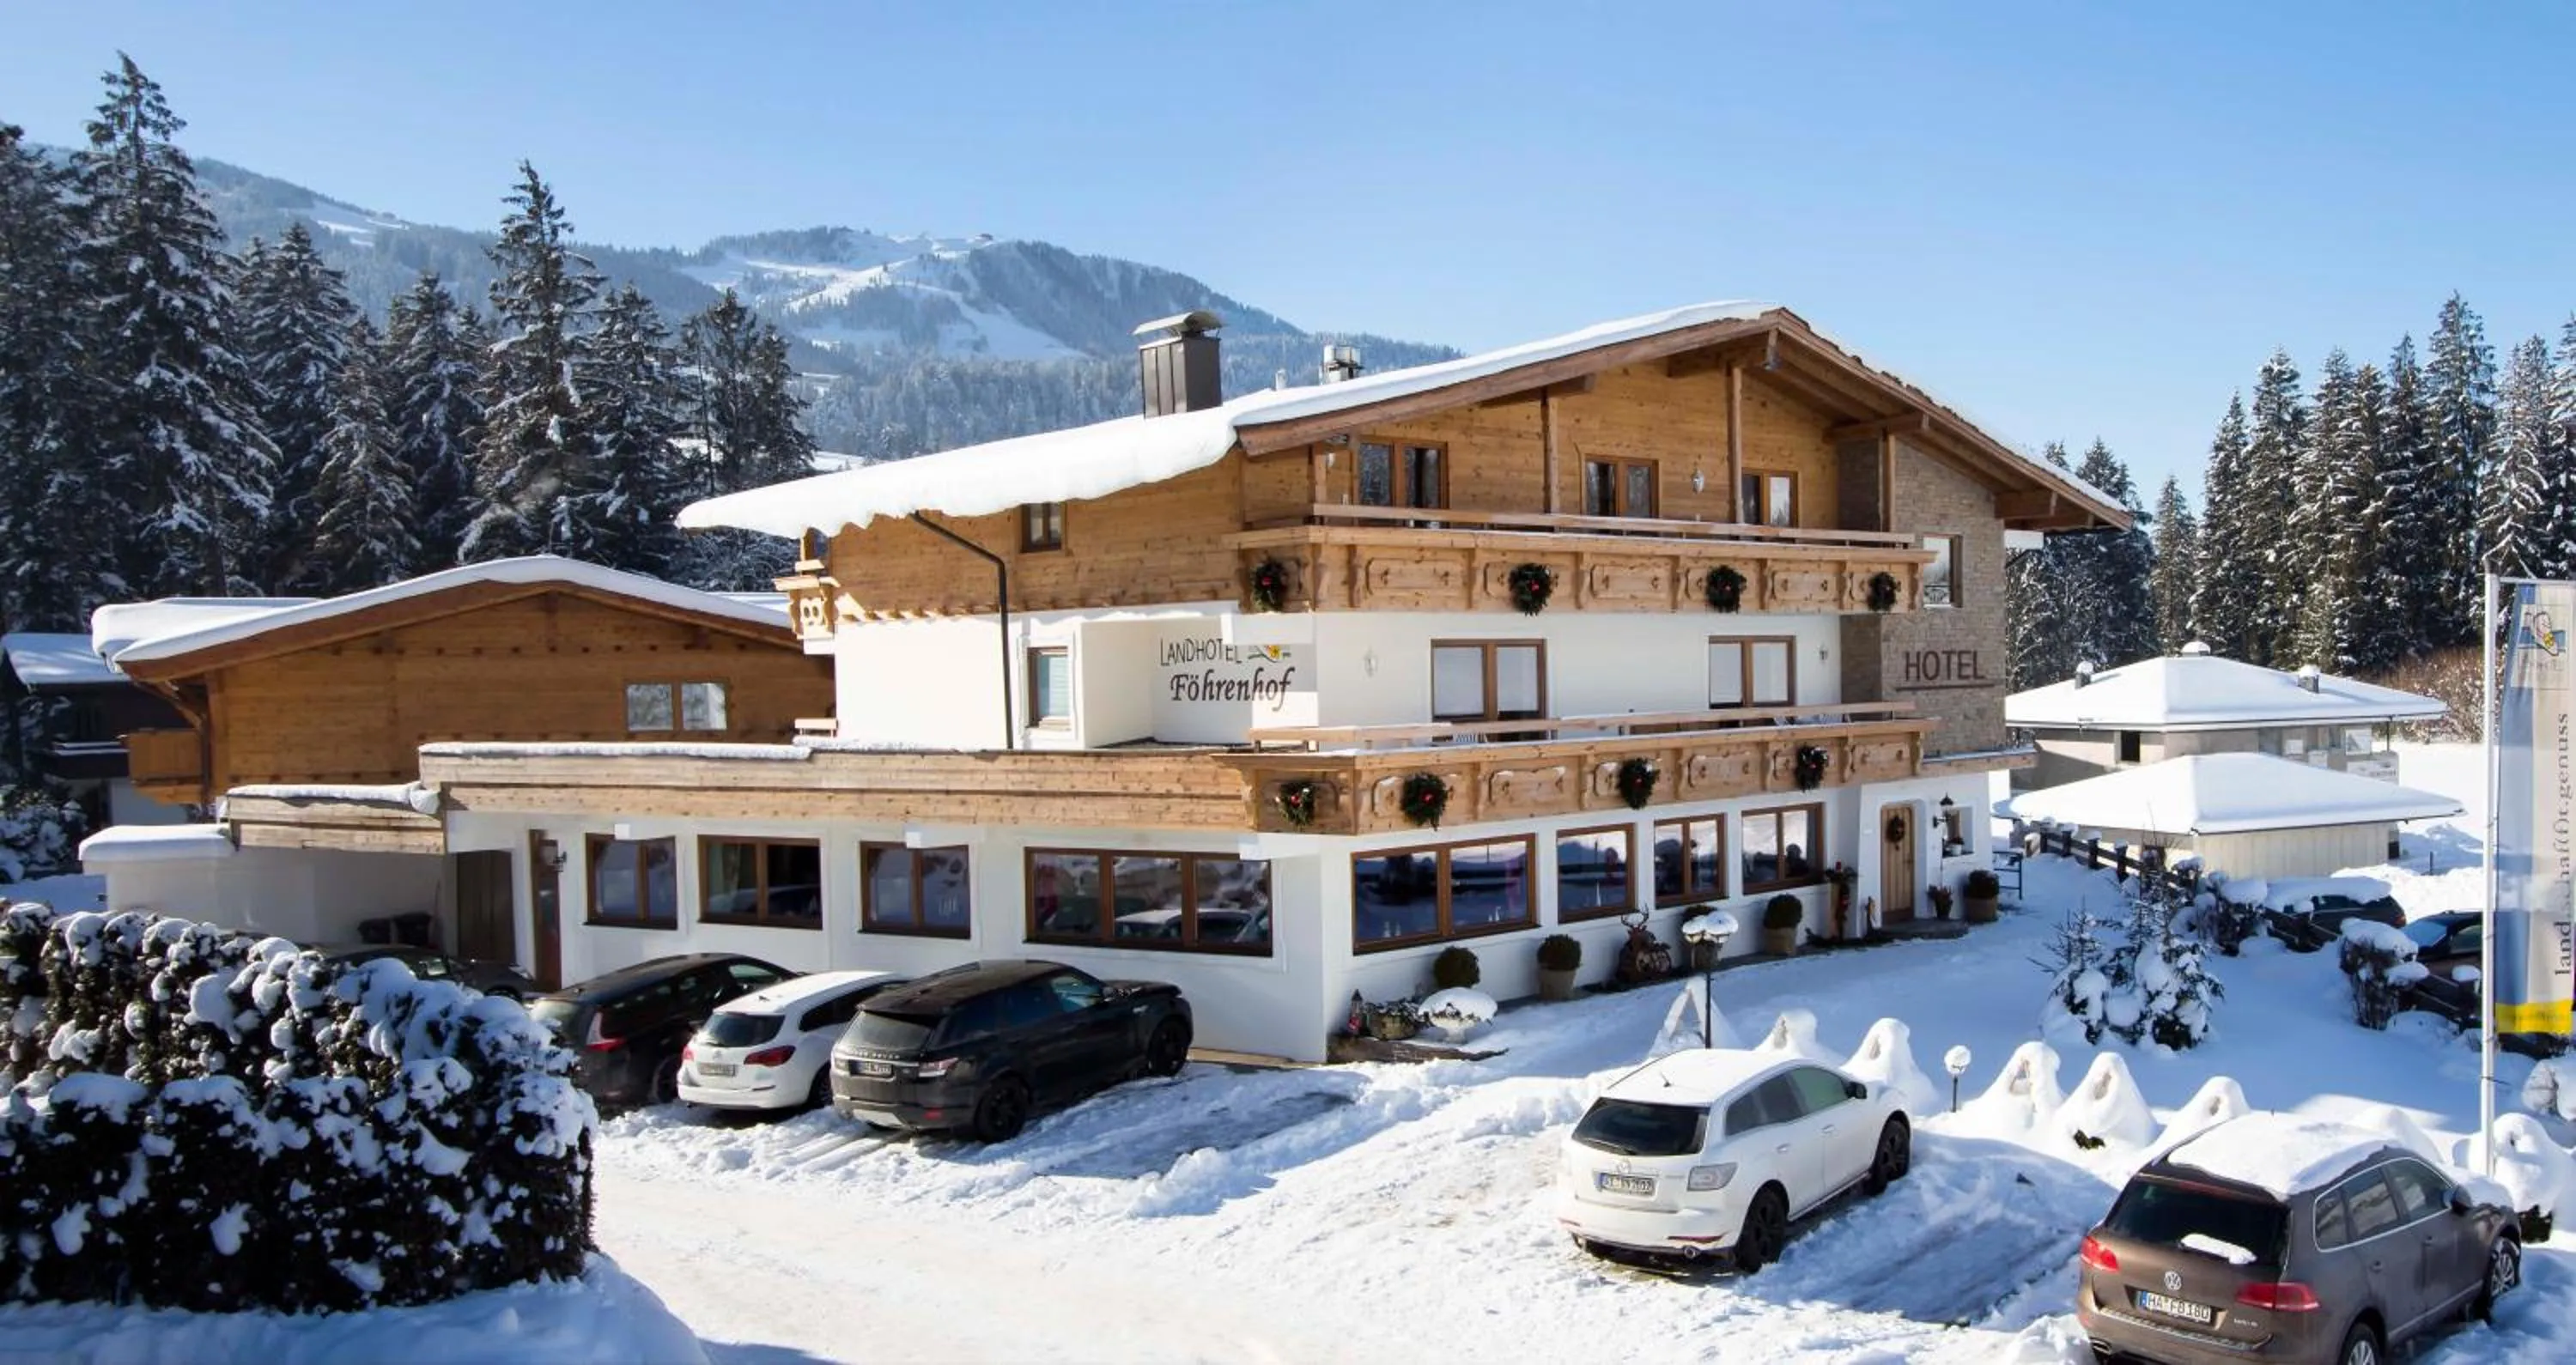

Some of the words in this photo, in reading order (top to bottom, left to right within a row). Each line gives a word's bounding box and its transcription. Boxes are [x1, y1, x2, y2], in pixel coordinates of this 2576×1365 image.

[1159, 638, 1242, 667] LANDHOTEL
[1905, 650, 1986, 682] HOTEL
[1170, 666, 1296, 712] Föhrenhof
